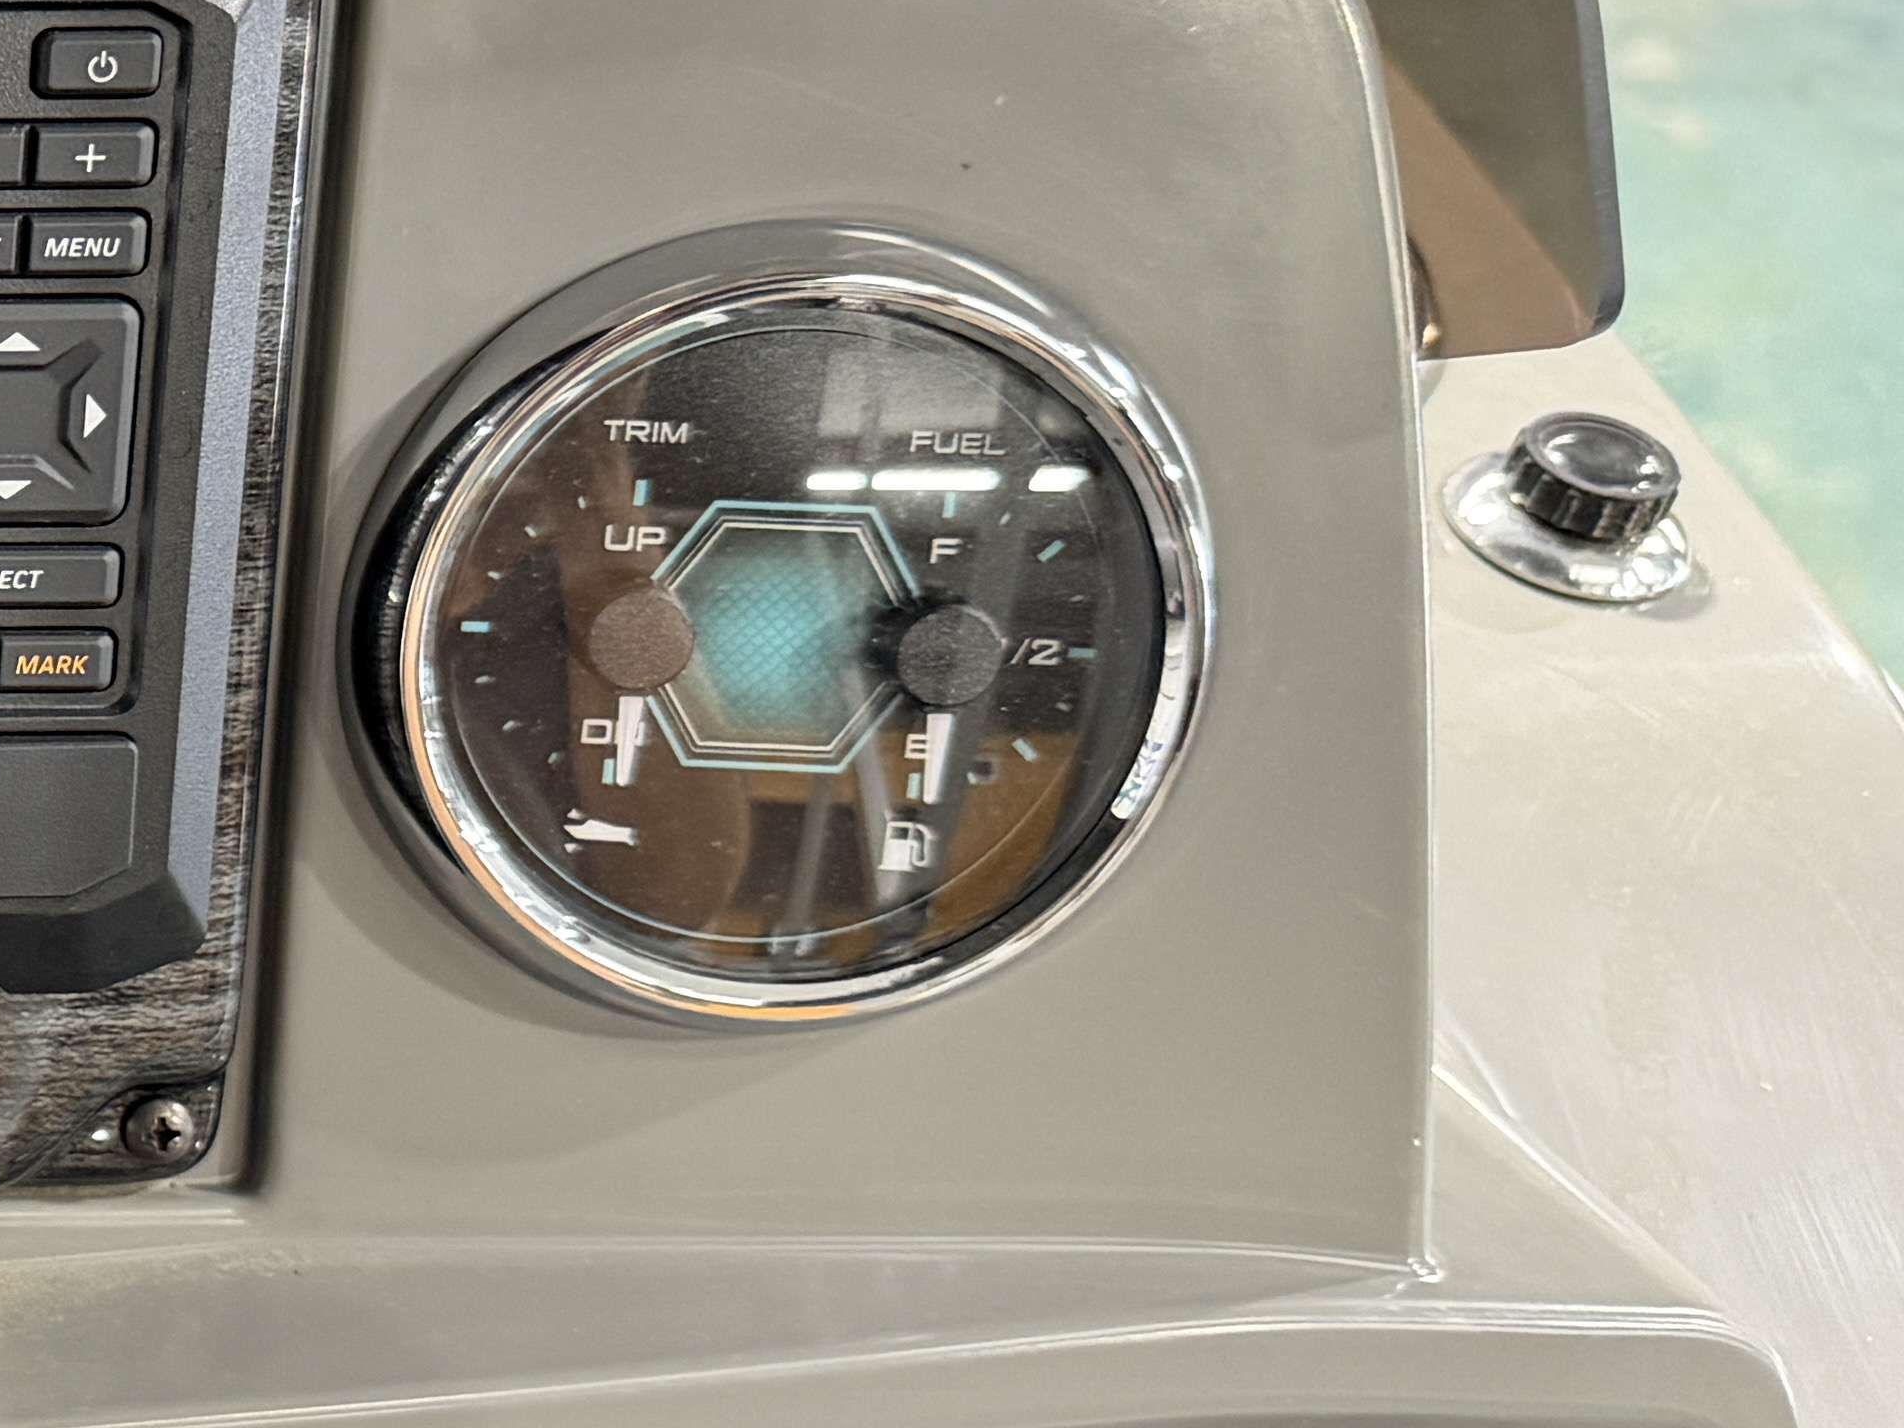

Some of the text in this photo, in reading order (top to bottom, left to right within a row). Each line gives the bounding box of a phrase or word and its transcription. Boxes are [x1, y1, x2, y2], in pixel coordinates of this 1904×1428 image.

[43, 237, 121, 259] MENU
[603, 419, 689, 444] TRIM
[909, 429, 1007, 457] FUEL
[604, 524, 668, 553] UP
[929, 537, 963, 565] F
[15, 655, 89, 676] MARK
